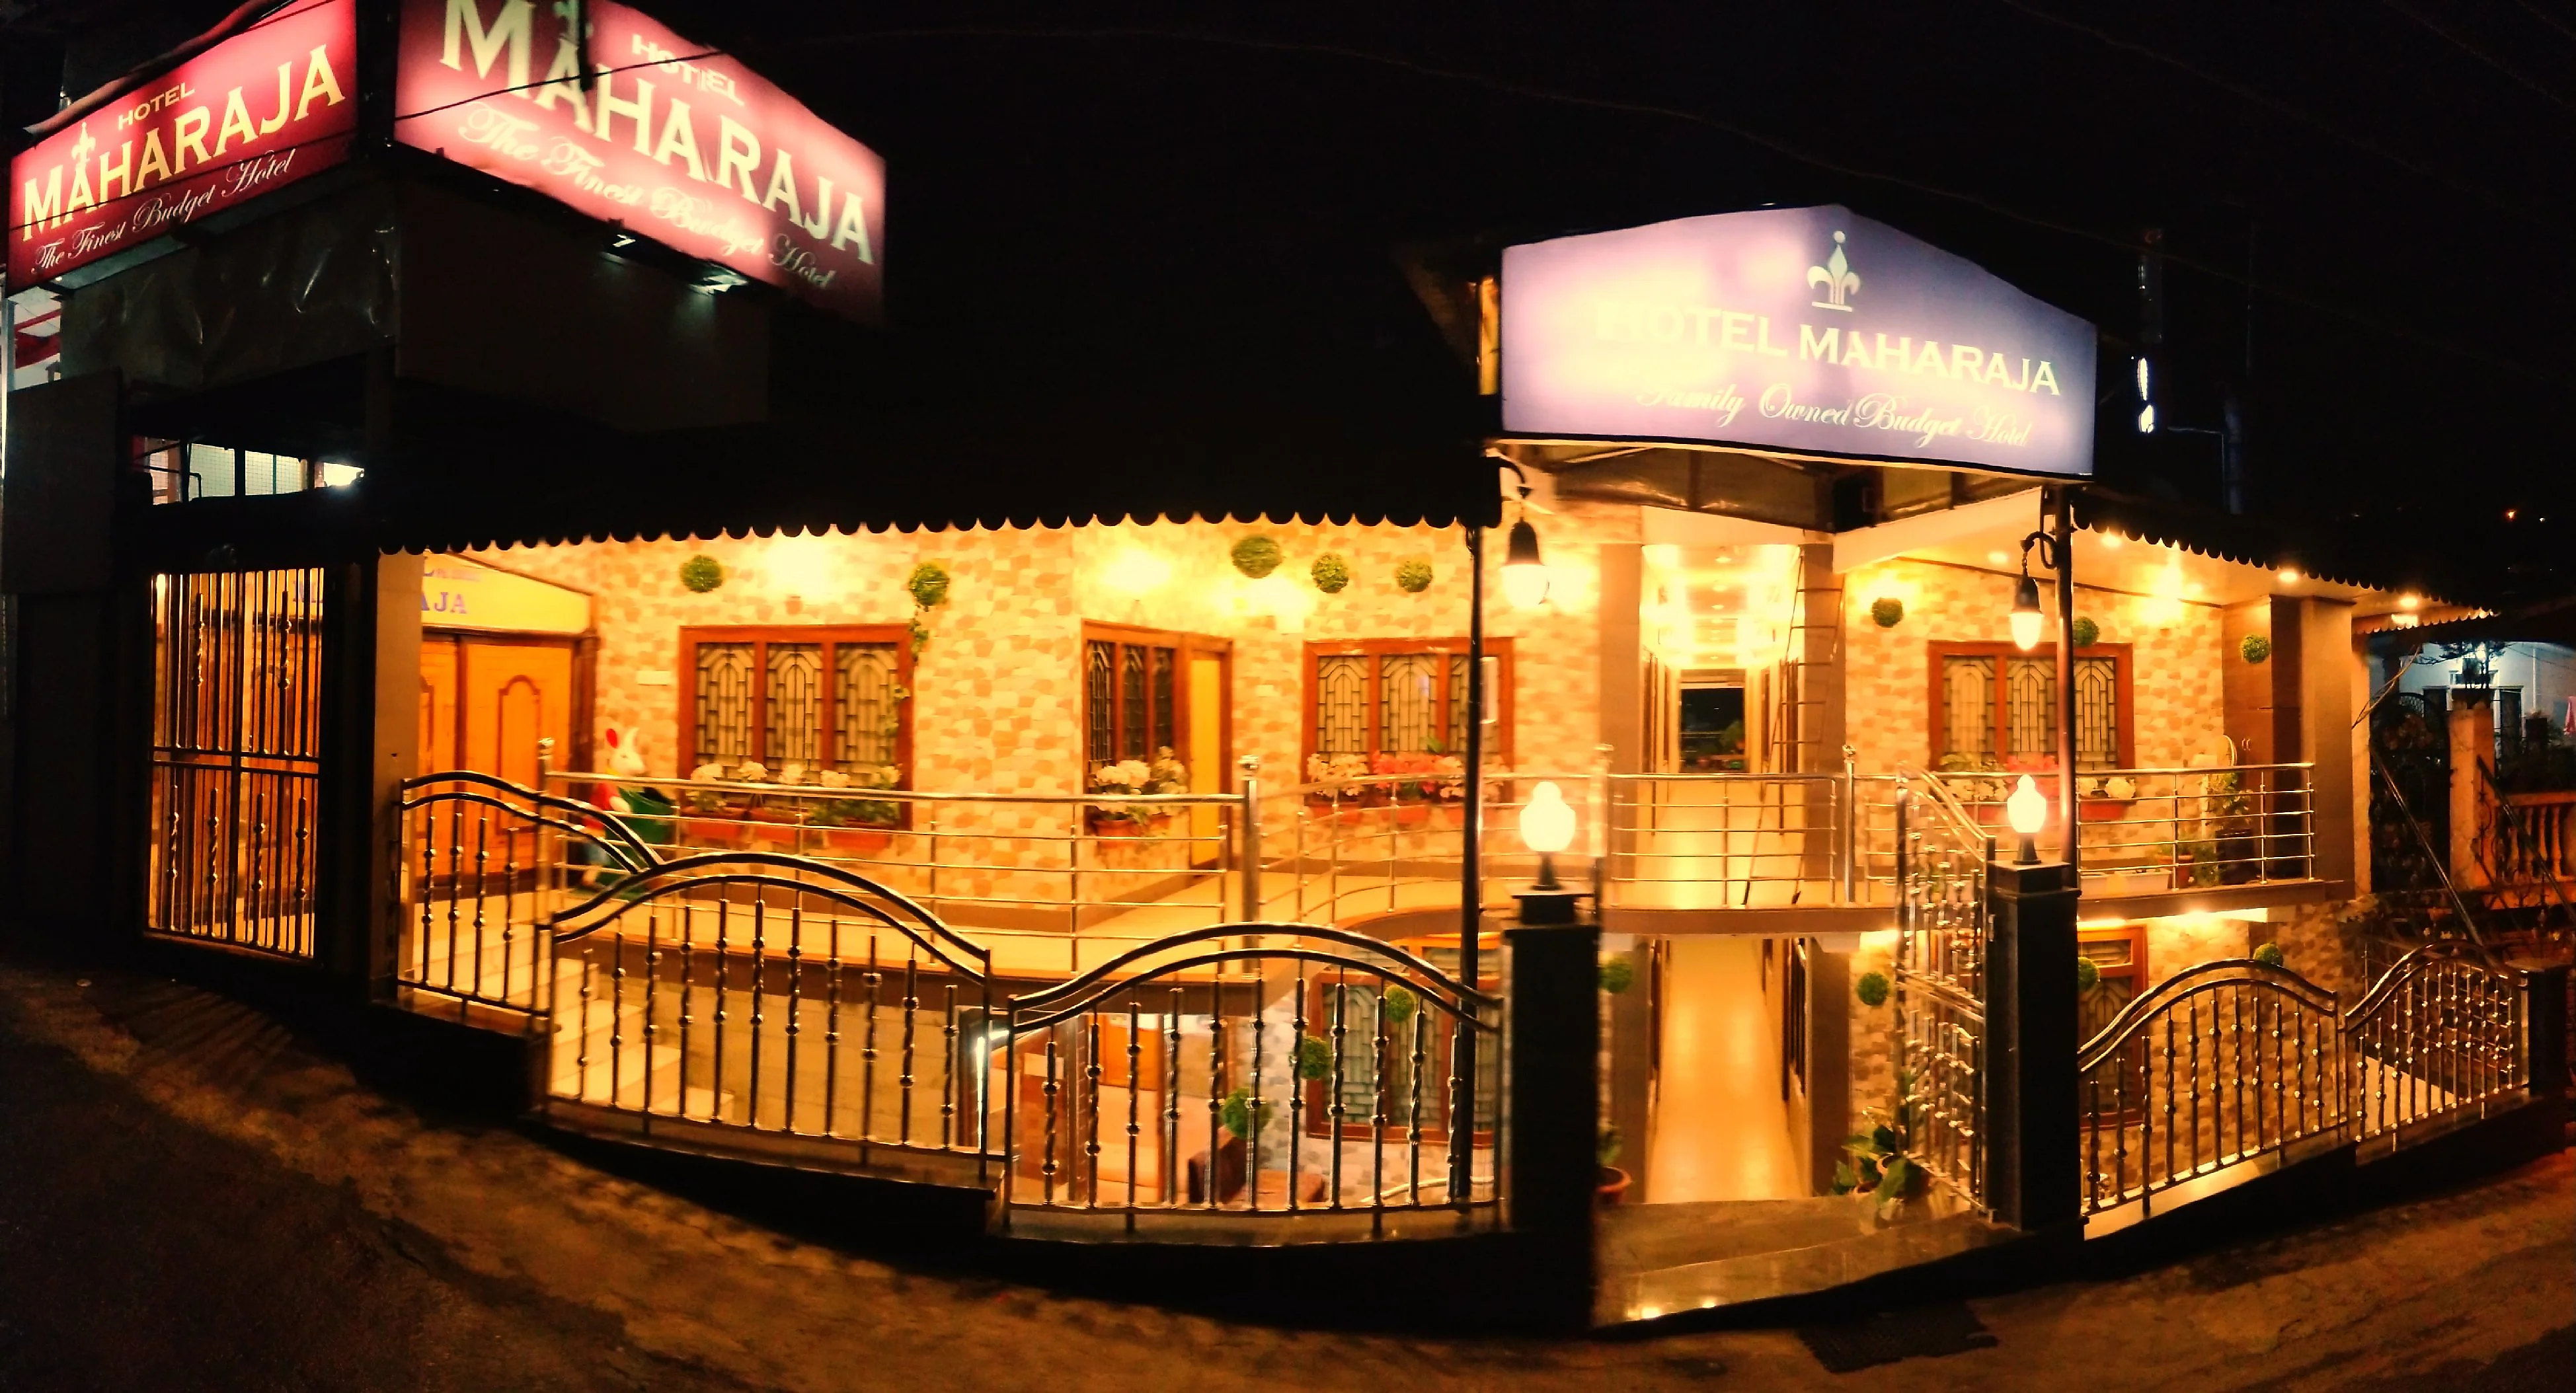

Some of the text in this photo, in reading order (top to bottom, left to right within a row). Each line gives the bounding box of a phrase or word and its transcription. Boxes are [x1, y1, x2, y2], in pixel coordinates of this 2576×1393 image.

[22, 44, 346, 242] MAHARAJA
[118, 82, 196, 130] HOTEL
[440, 0, 873, 264] MAHARAJA
[457, 101, 541, 161] The
[31, 148, 297, 274] The Finest Budget Hotel
[1595, 301, 2061, 396] HOTEL MAHARAJA
[1635, 382, 2031, 449] Family Owned Budget Hotel
